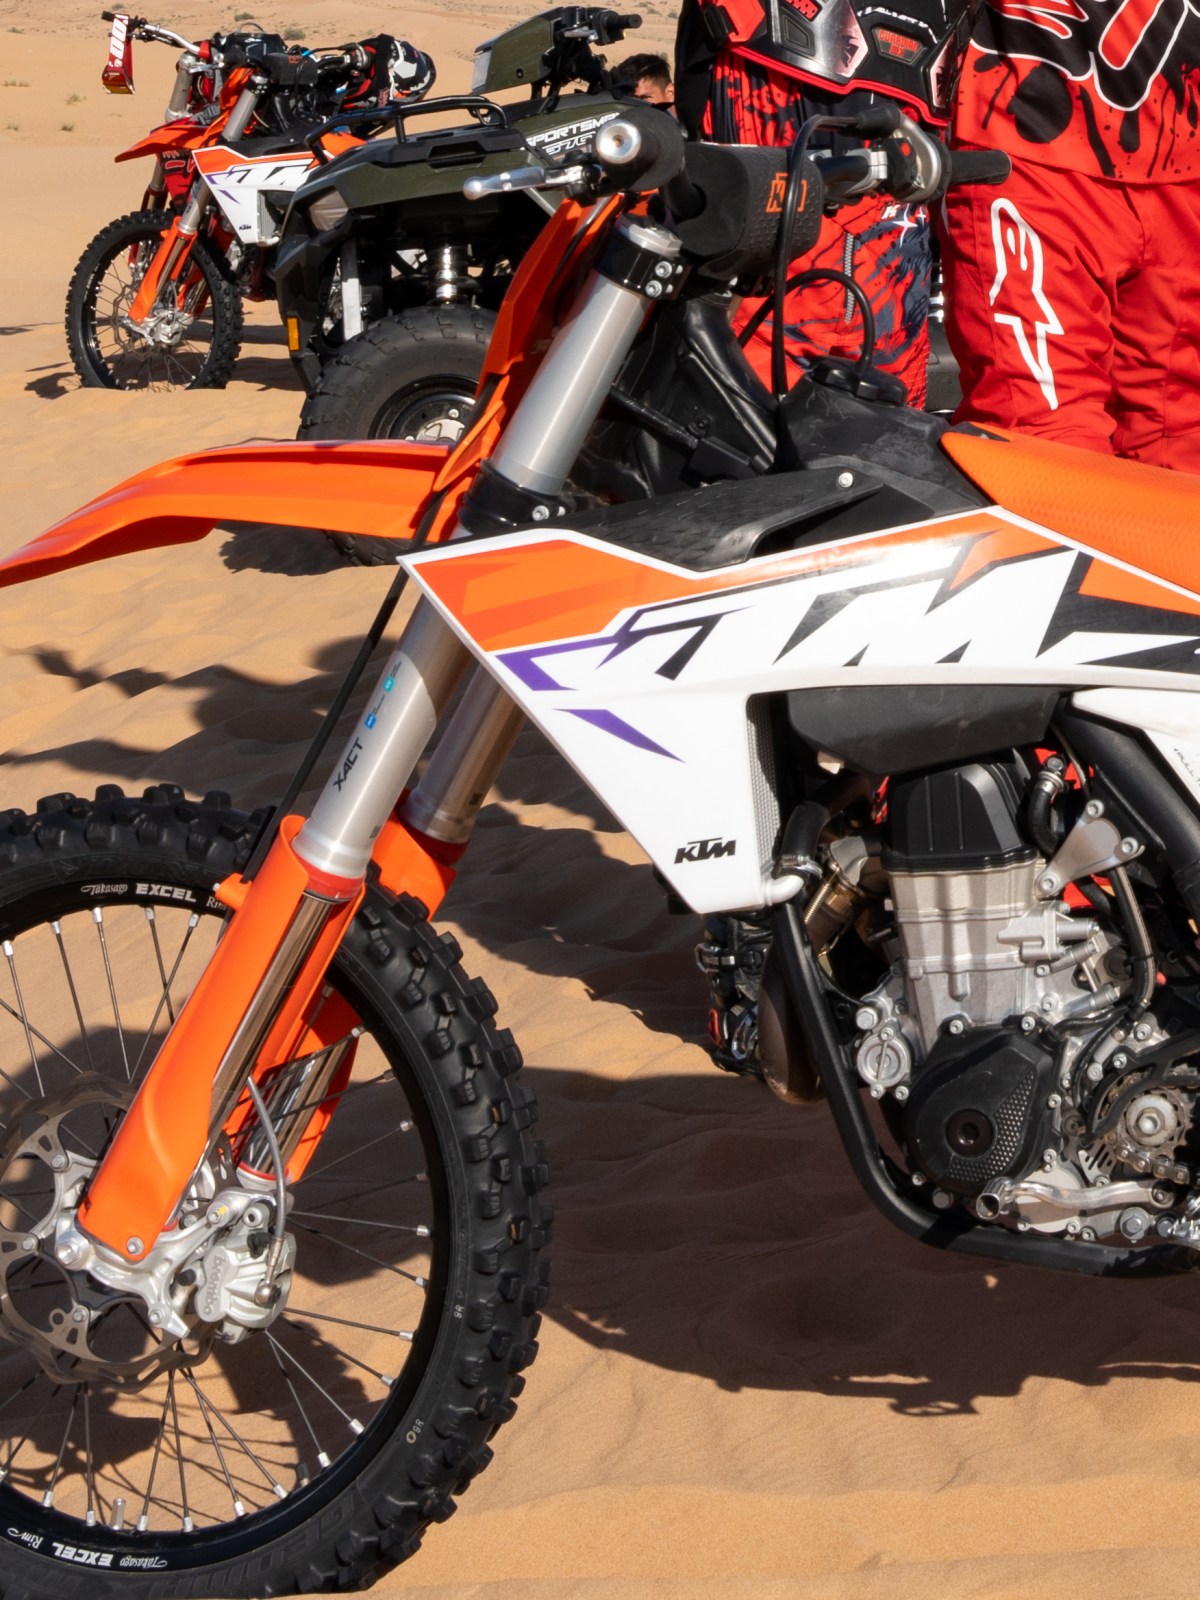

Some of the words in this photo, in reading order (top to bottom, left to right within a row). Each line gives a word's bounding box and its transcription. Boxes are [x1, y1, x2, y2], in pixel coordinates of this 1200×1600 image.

[332, 736, 364, 792] XACT
[673, 836, 737, 865] KTM
[135, 882, 197, 903] EXCEL
[7, 1527, 44, 1549] Rim
[51, 1541, 114, 1568] EXCEL
